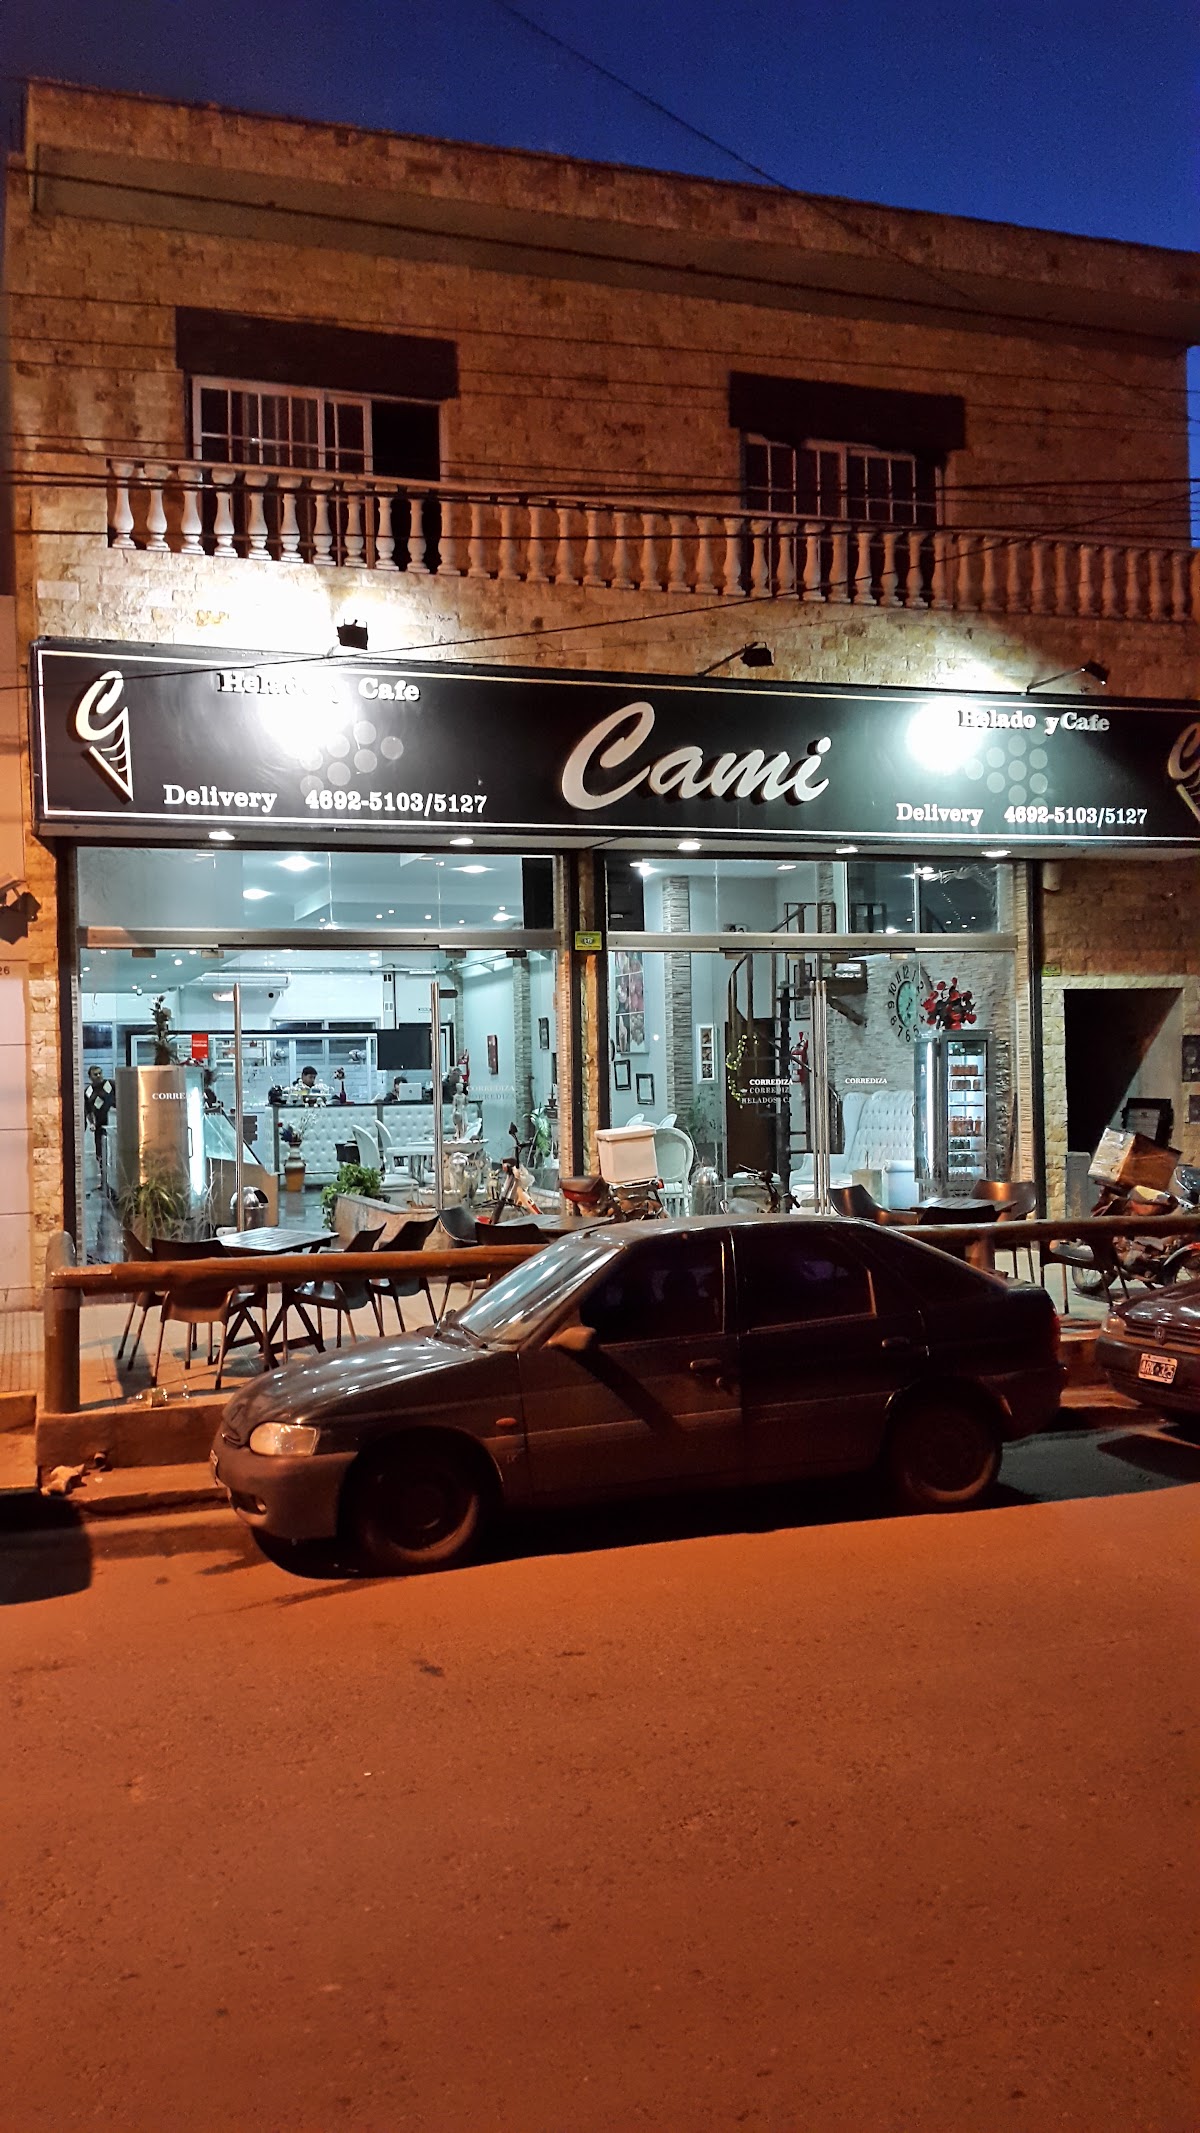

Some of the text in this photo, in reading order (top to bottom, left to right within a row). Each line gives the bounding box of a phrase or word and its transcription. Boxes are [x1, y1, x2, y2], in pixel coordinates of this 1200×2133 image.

[358, 677, 419, 701] Cafe
[957, 710, 1110, 734] Helado y Cafe
[561, 701, 832, 811] Cami
[163, 784, 278, 813] Delivery
[304, 790, 488, 816] 4692-5103/5127
[896, 803, 984, 827] Delivery
[1003, 806, 1148, 828] 4692-5103/5127
[749, 1078, 793, 1086] CORREDIZA
[151, 1092, 209, 1100] CORREA
